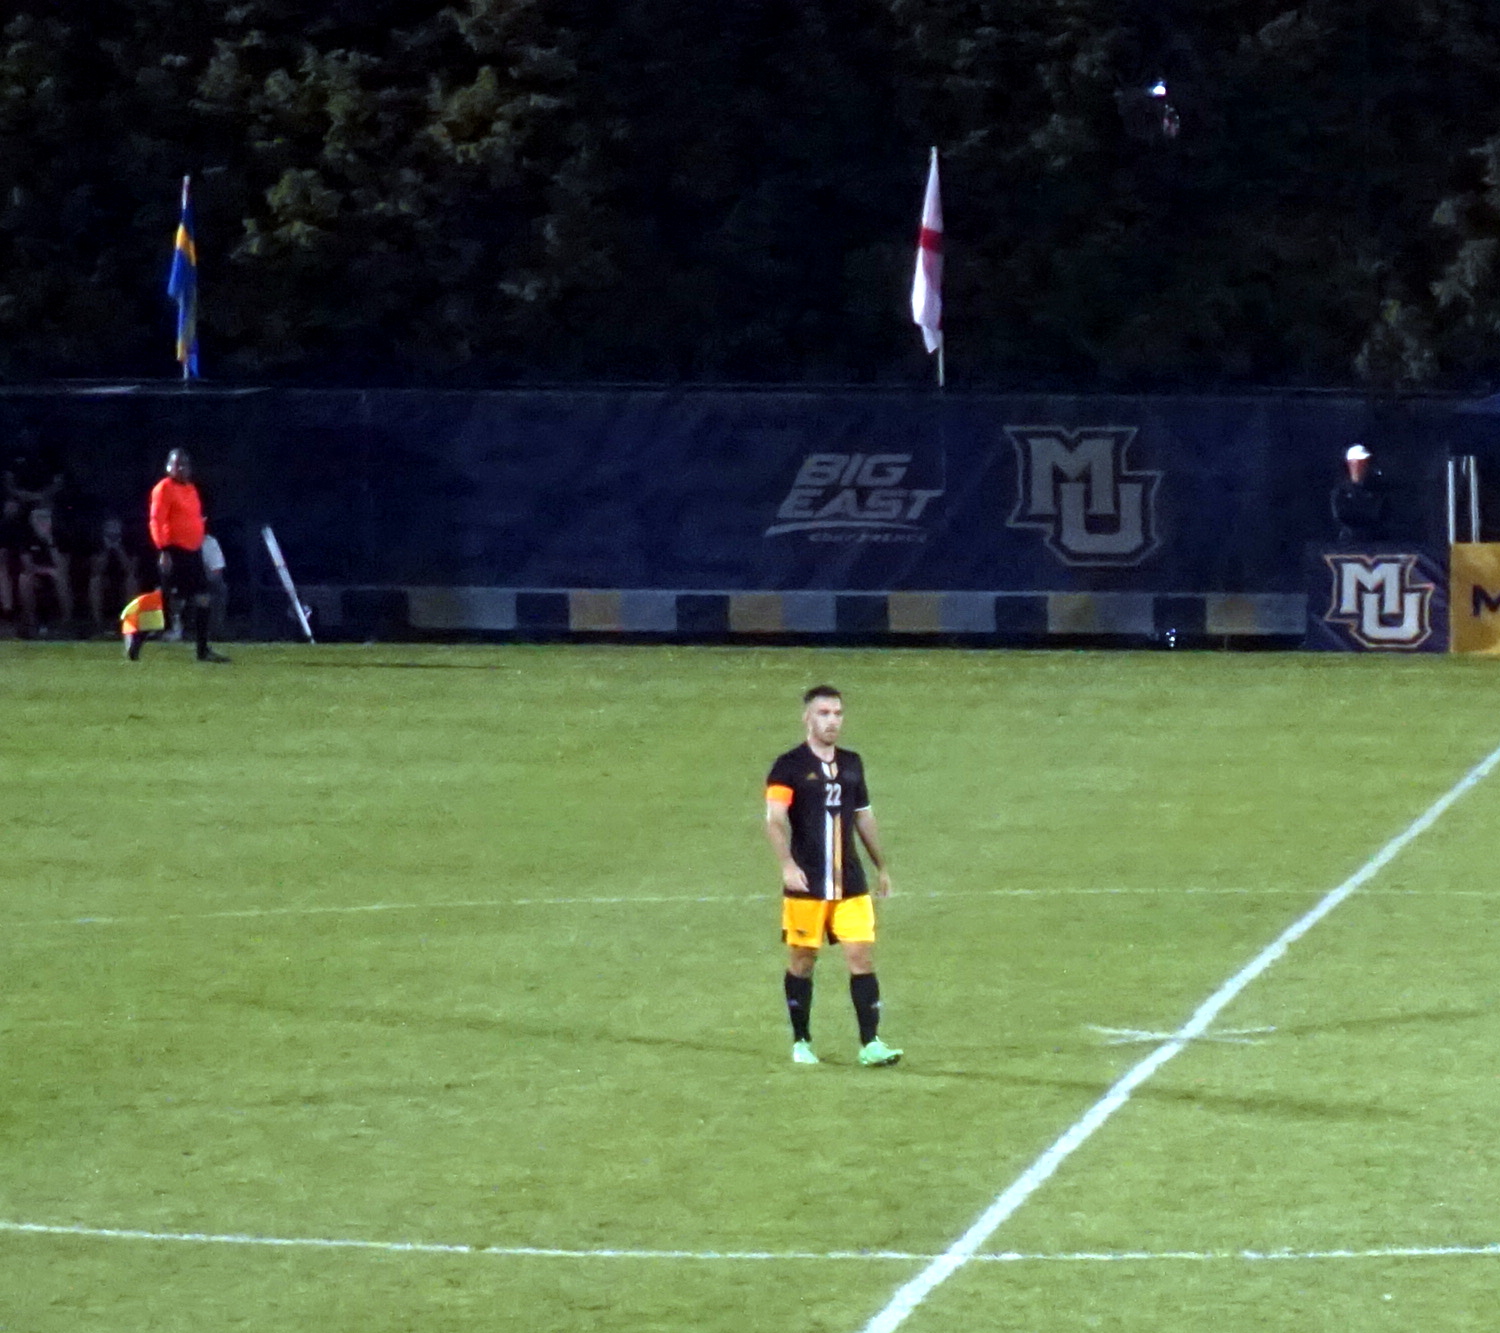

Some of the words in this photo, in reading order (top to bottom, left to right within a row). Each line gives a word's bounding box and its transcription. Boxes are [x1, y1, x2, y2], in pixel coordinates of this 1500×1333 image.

[793, 452, 913, 487] BIG
[776, 488, 945, 520] EAST
[1016, 430, 1154, 561] MU
[1333, 557, 1429, 645] MU
[825, 782, 842, 807] 22
